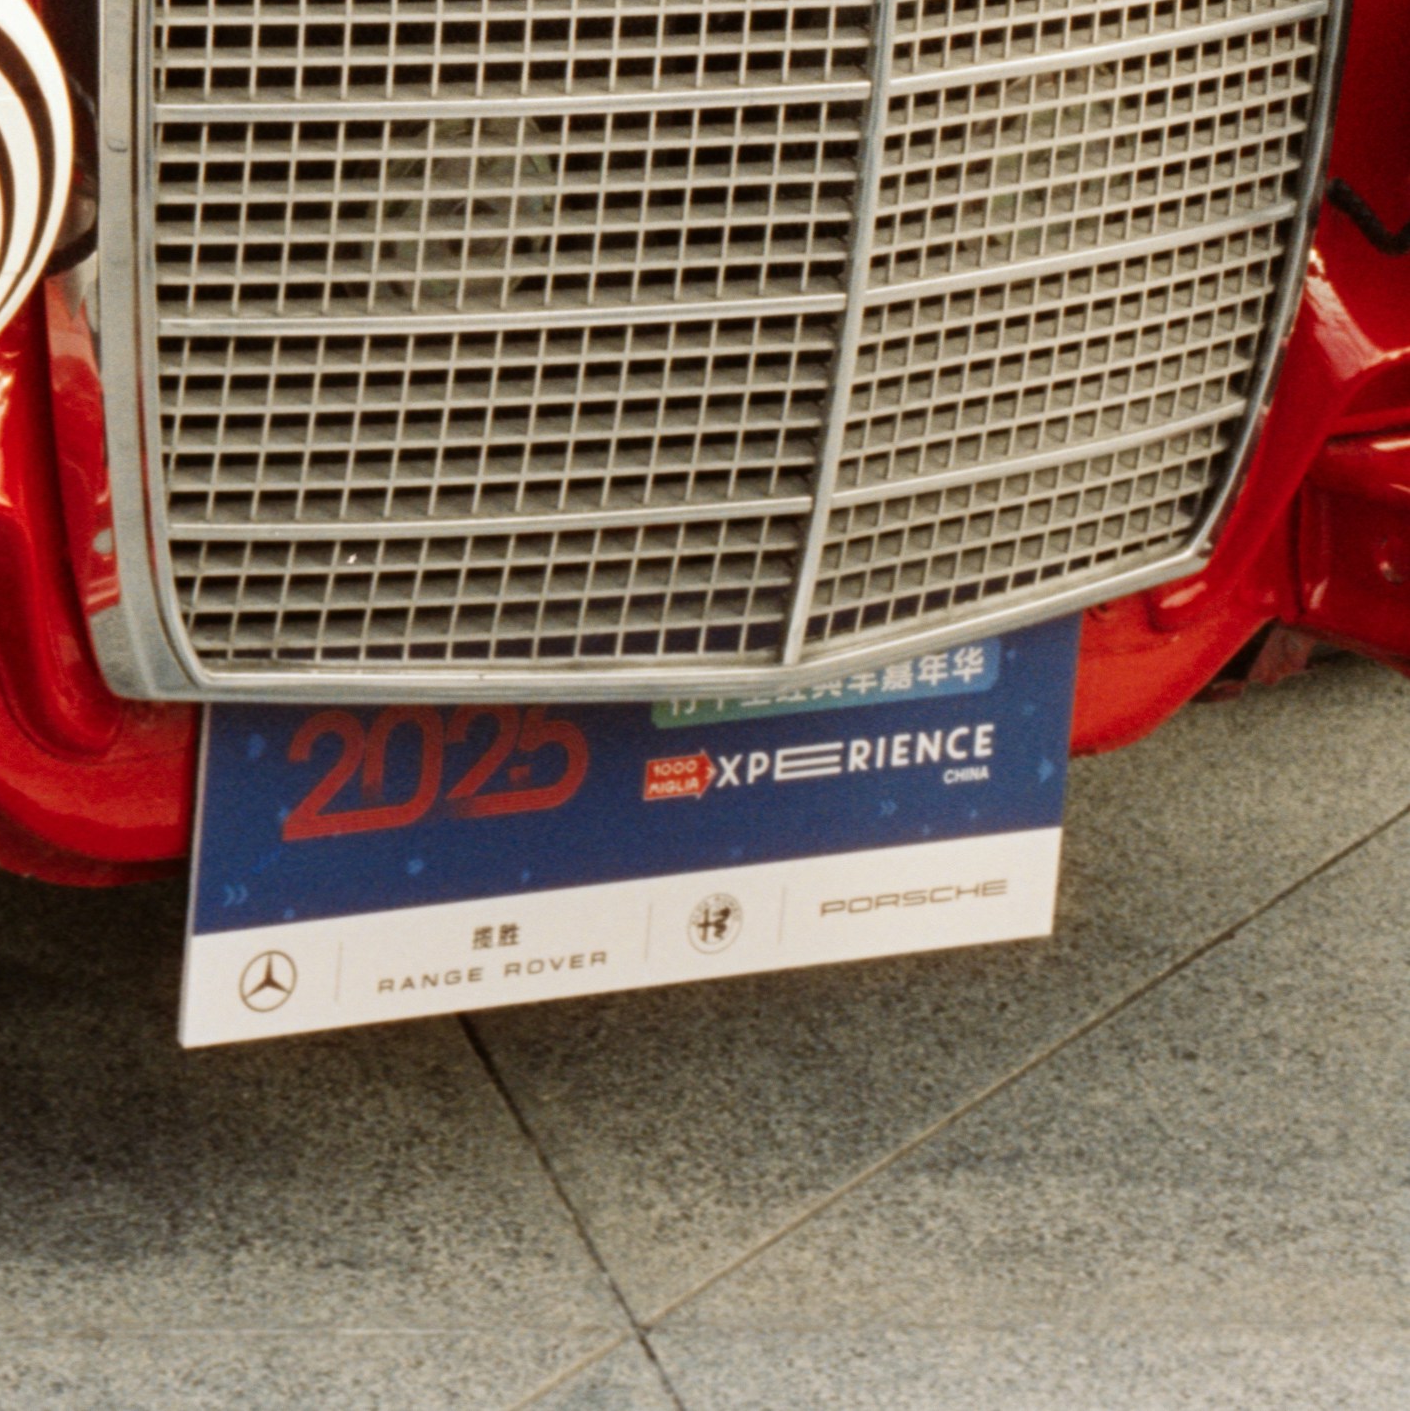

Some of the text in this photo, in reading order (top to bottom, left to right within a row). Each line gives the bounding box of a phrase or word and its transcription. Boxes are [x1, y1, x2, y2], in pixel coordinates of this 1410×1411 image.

[282, 704, 589, 843] 2025
[943, 765, 990, 785] CHINA
[820, 879, 1008, 917] PORSCHE
[376, 950, 609, 994] RANGE ROVER
